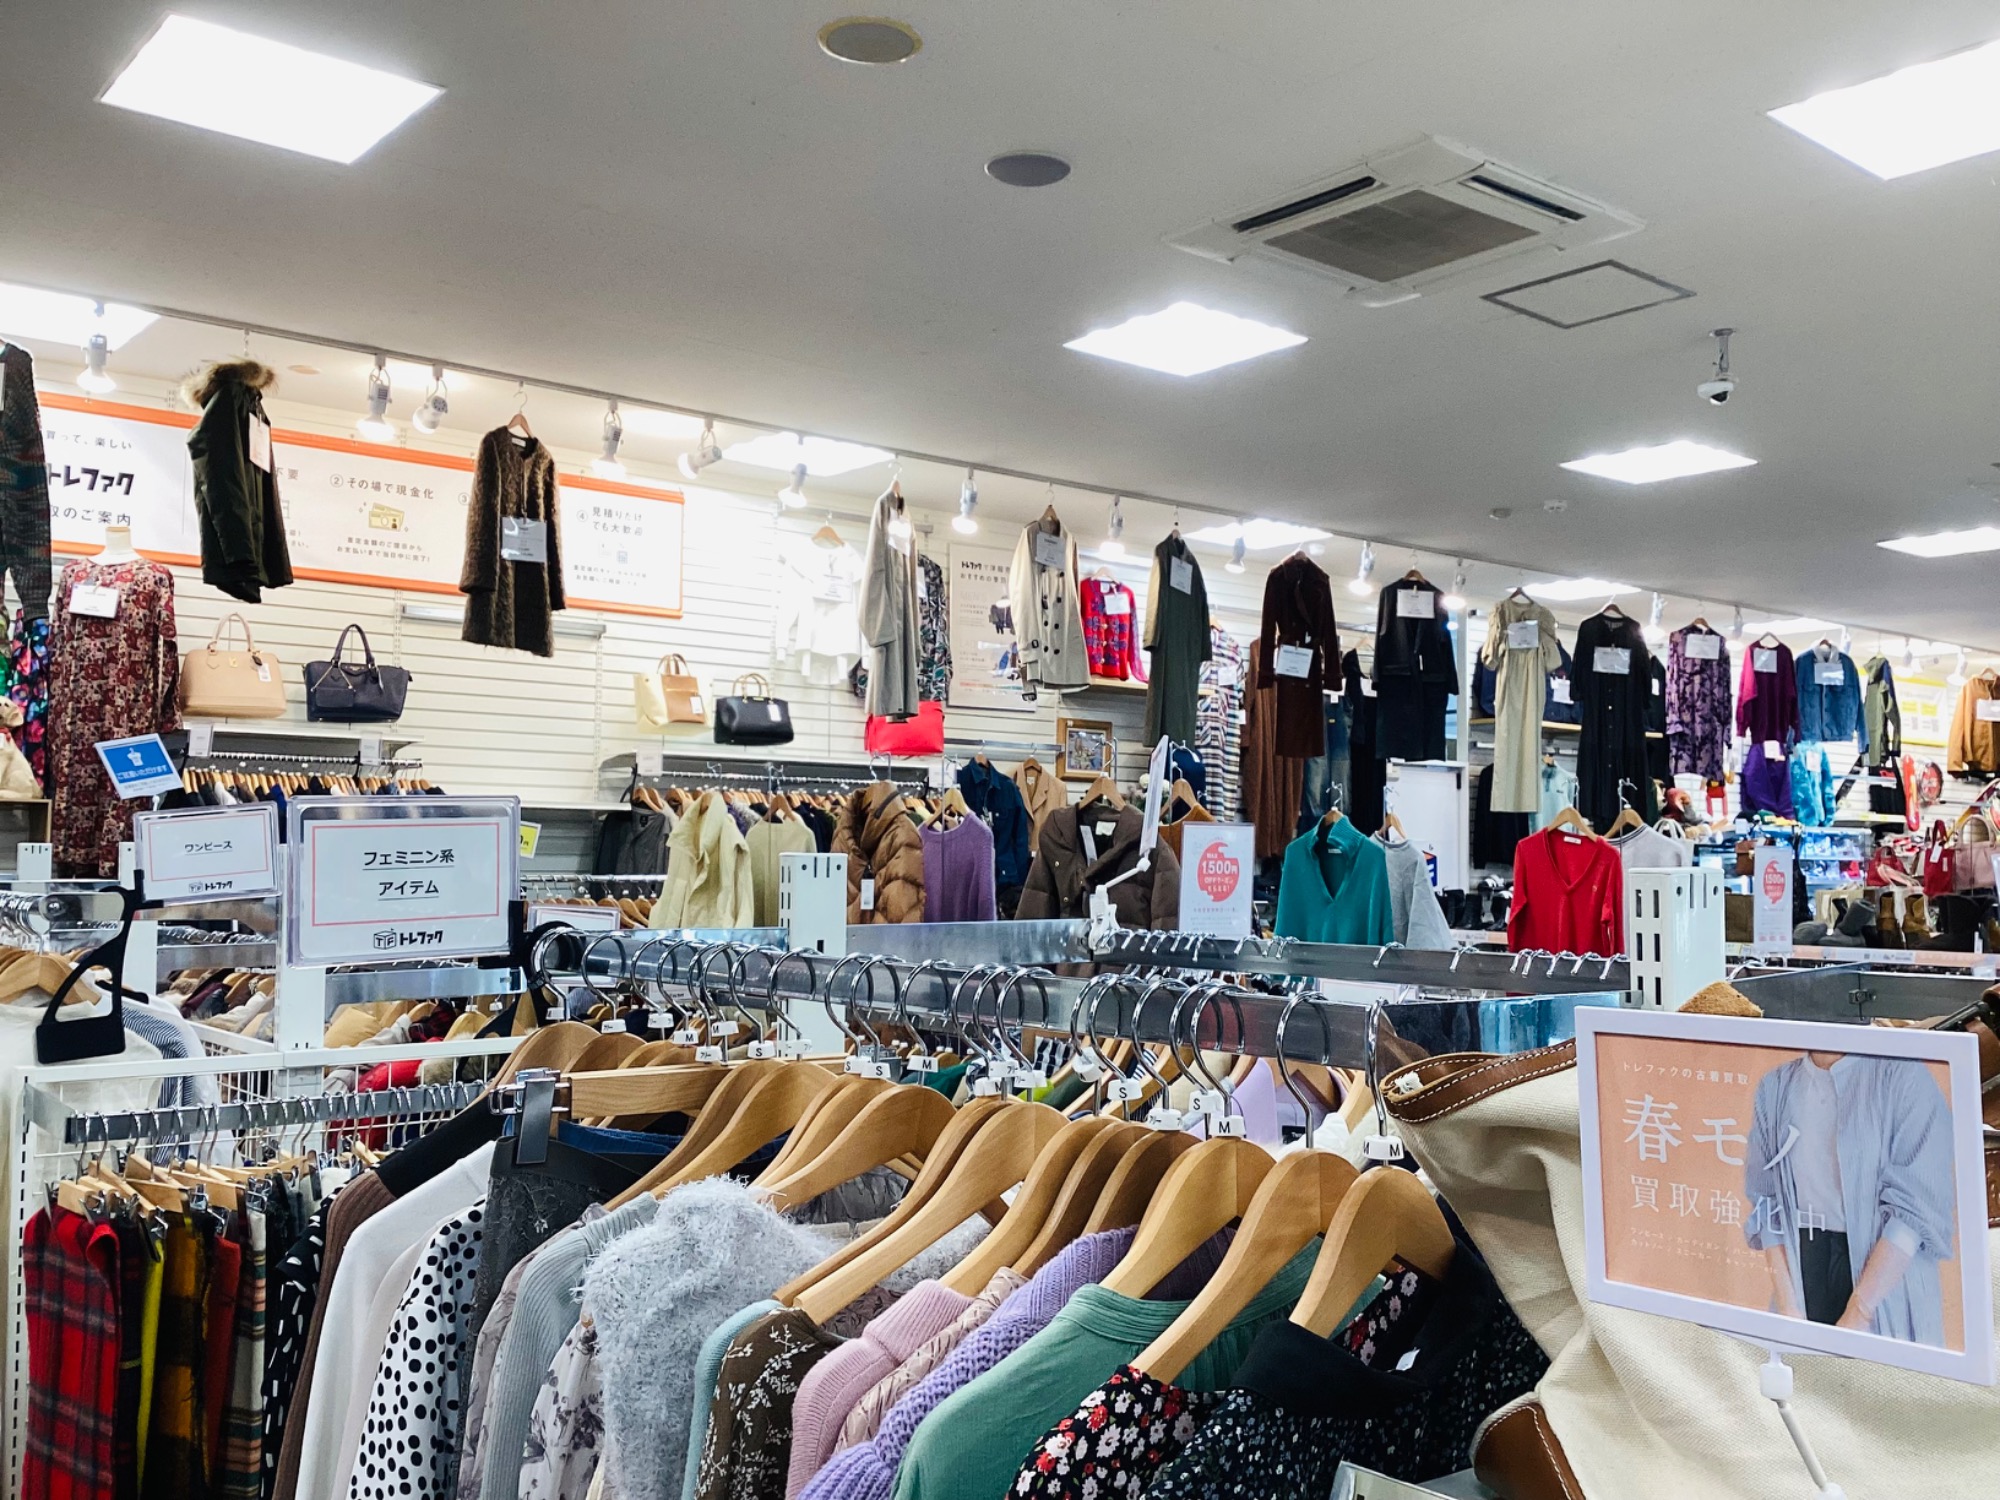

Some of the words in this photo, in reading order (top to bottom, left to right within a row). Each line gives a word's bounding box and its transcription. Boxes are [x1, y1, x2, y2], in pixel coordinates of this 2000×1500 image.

[347, 477, 434, 500] その場で現金化
[184, 840, 233, 853] ワンピース
[363, 848, 455, 866] フェミニン系
[379, 880, 440, 896] アイテム
[399, 929, 444, 946] トレファク
[1118, 1086, 1128, 1099] S
[1218, 1121, 1231, 1134] M
[1389, 1143, 1401, 1157] M
[1630, 1174, 1827, 1242] 買取強化中
